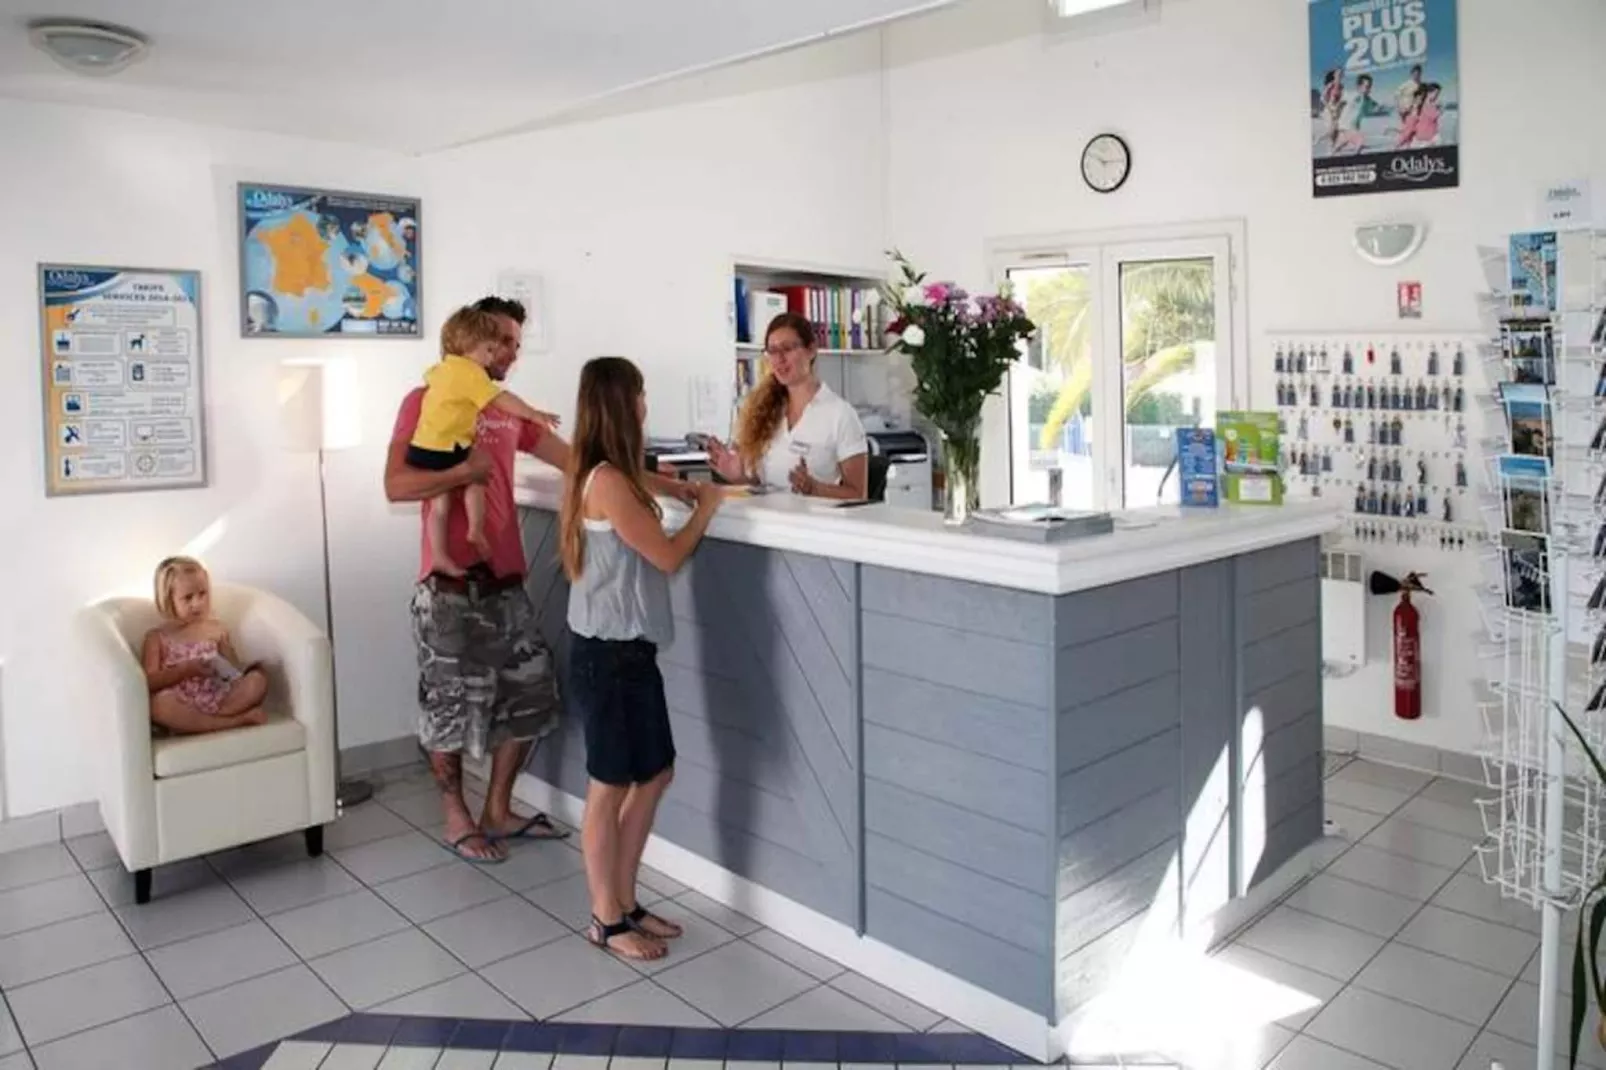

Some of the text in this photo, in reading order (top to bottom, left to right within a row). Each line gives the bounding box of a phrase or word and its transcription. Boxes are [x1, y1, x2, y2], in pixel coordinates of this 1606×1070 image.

[1343, 1, 1426, 39] PLUS
[1344, 27, 1427, 71] 200
[1391, 154, 1445, 176] Odalys
